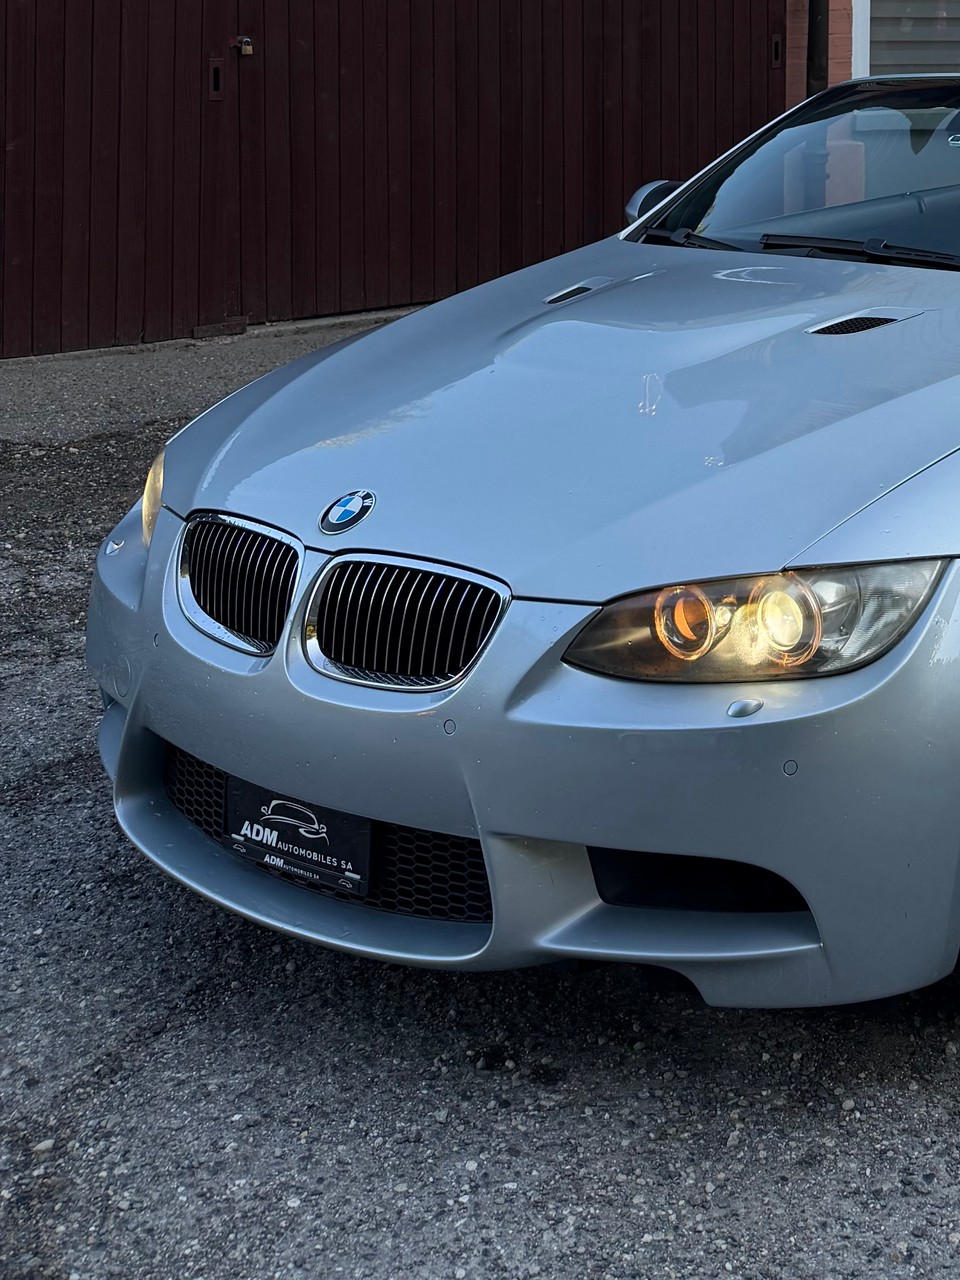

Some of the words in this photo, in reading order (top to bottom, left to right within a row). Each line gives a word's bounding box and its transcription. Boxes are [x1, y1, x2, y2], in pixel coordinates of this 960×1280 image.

[240, 820, 278, 847] ADM
[277, 841, 337, 866] AUTOMOBILES
[341, 860, 353, 870] SA
[264, 854, 284, 868] ADM
